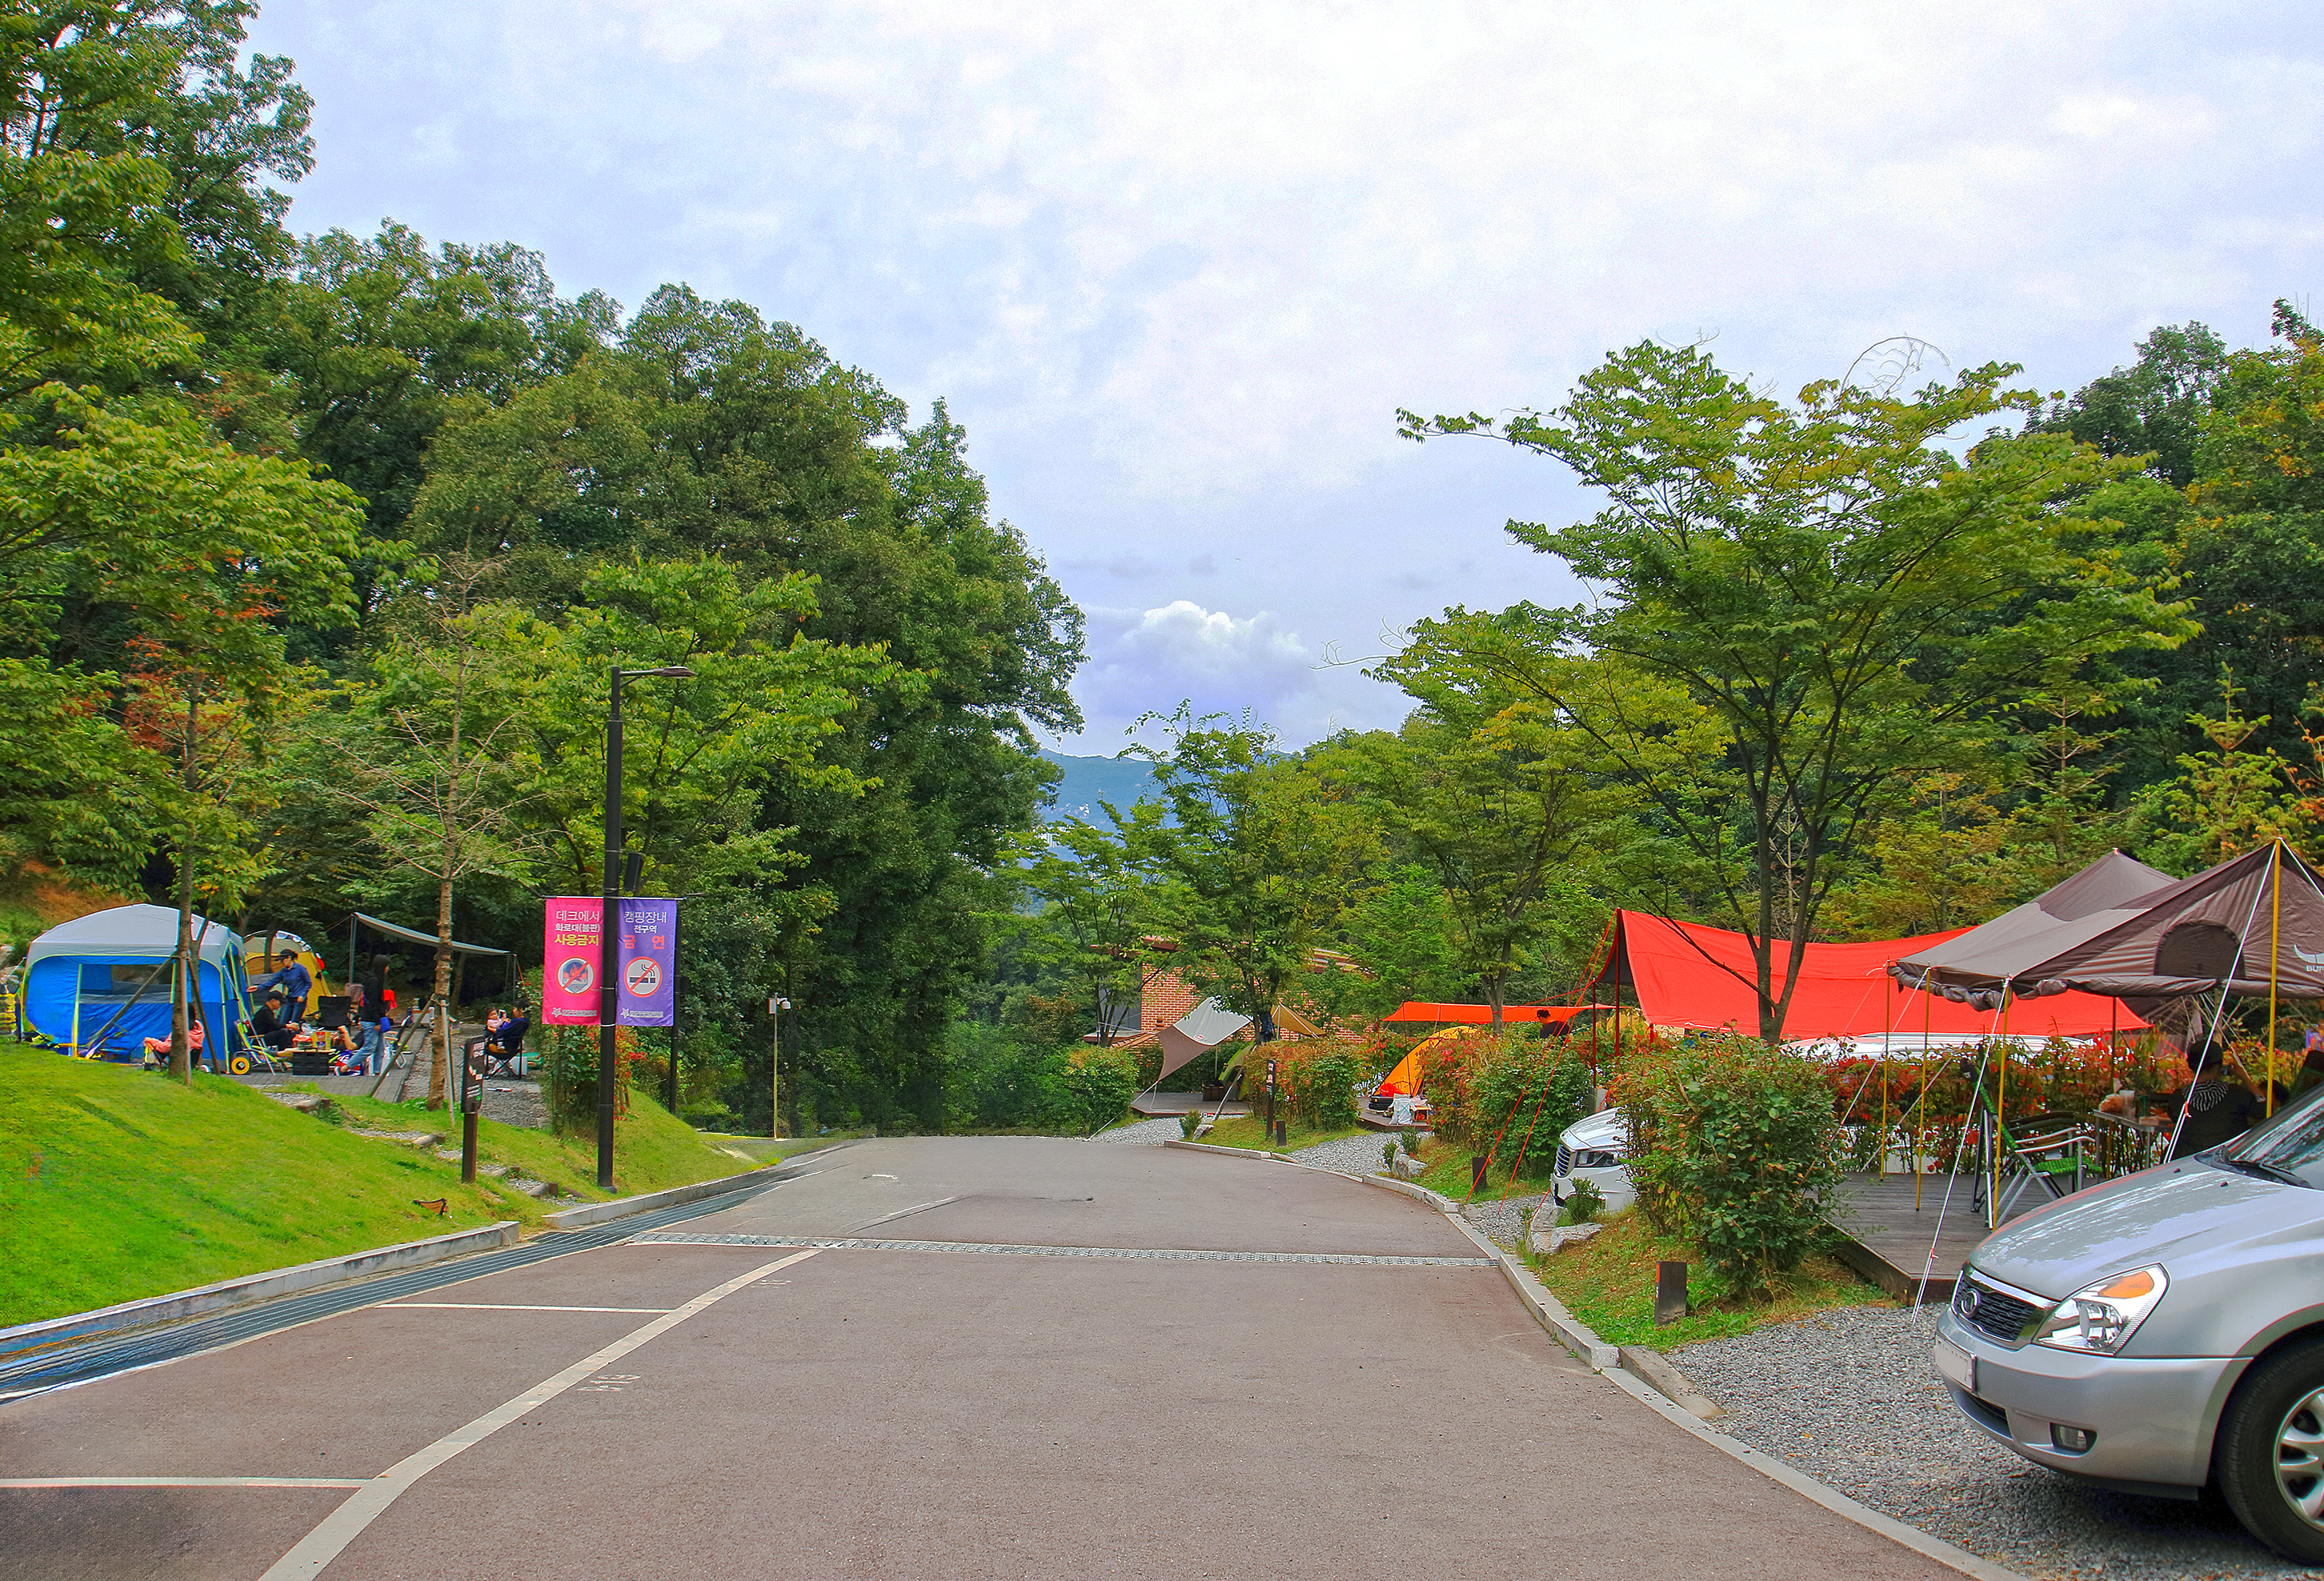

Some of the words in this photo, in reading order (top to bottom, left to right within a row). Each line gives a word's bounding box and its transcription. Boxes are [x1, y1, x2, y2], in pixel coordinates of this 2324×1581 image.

[555, 910, 600, 922] 데크에서
[623, 911, 667, 924] 캠핑장내
[634, 924, 658, 934] 전구역
[554, 934, 599, 947] 사용금지
